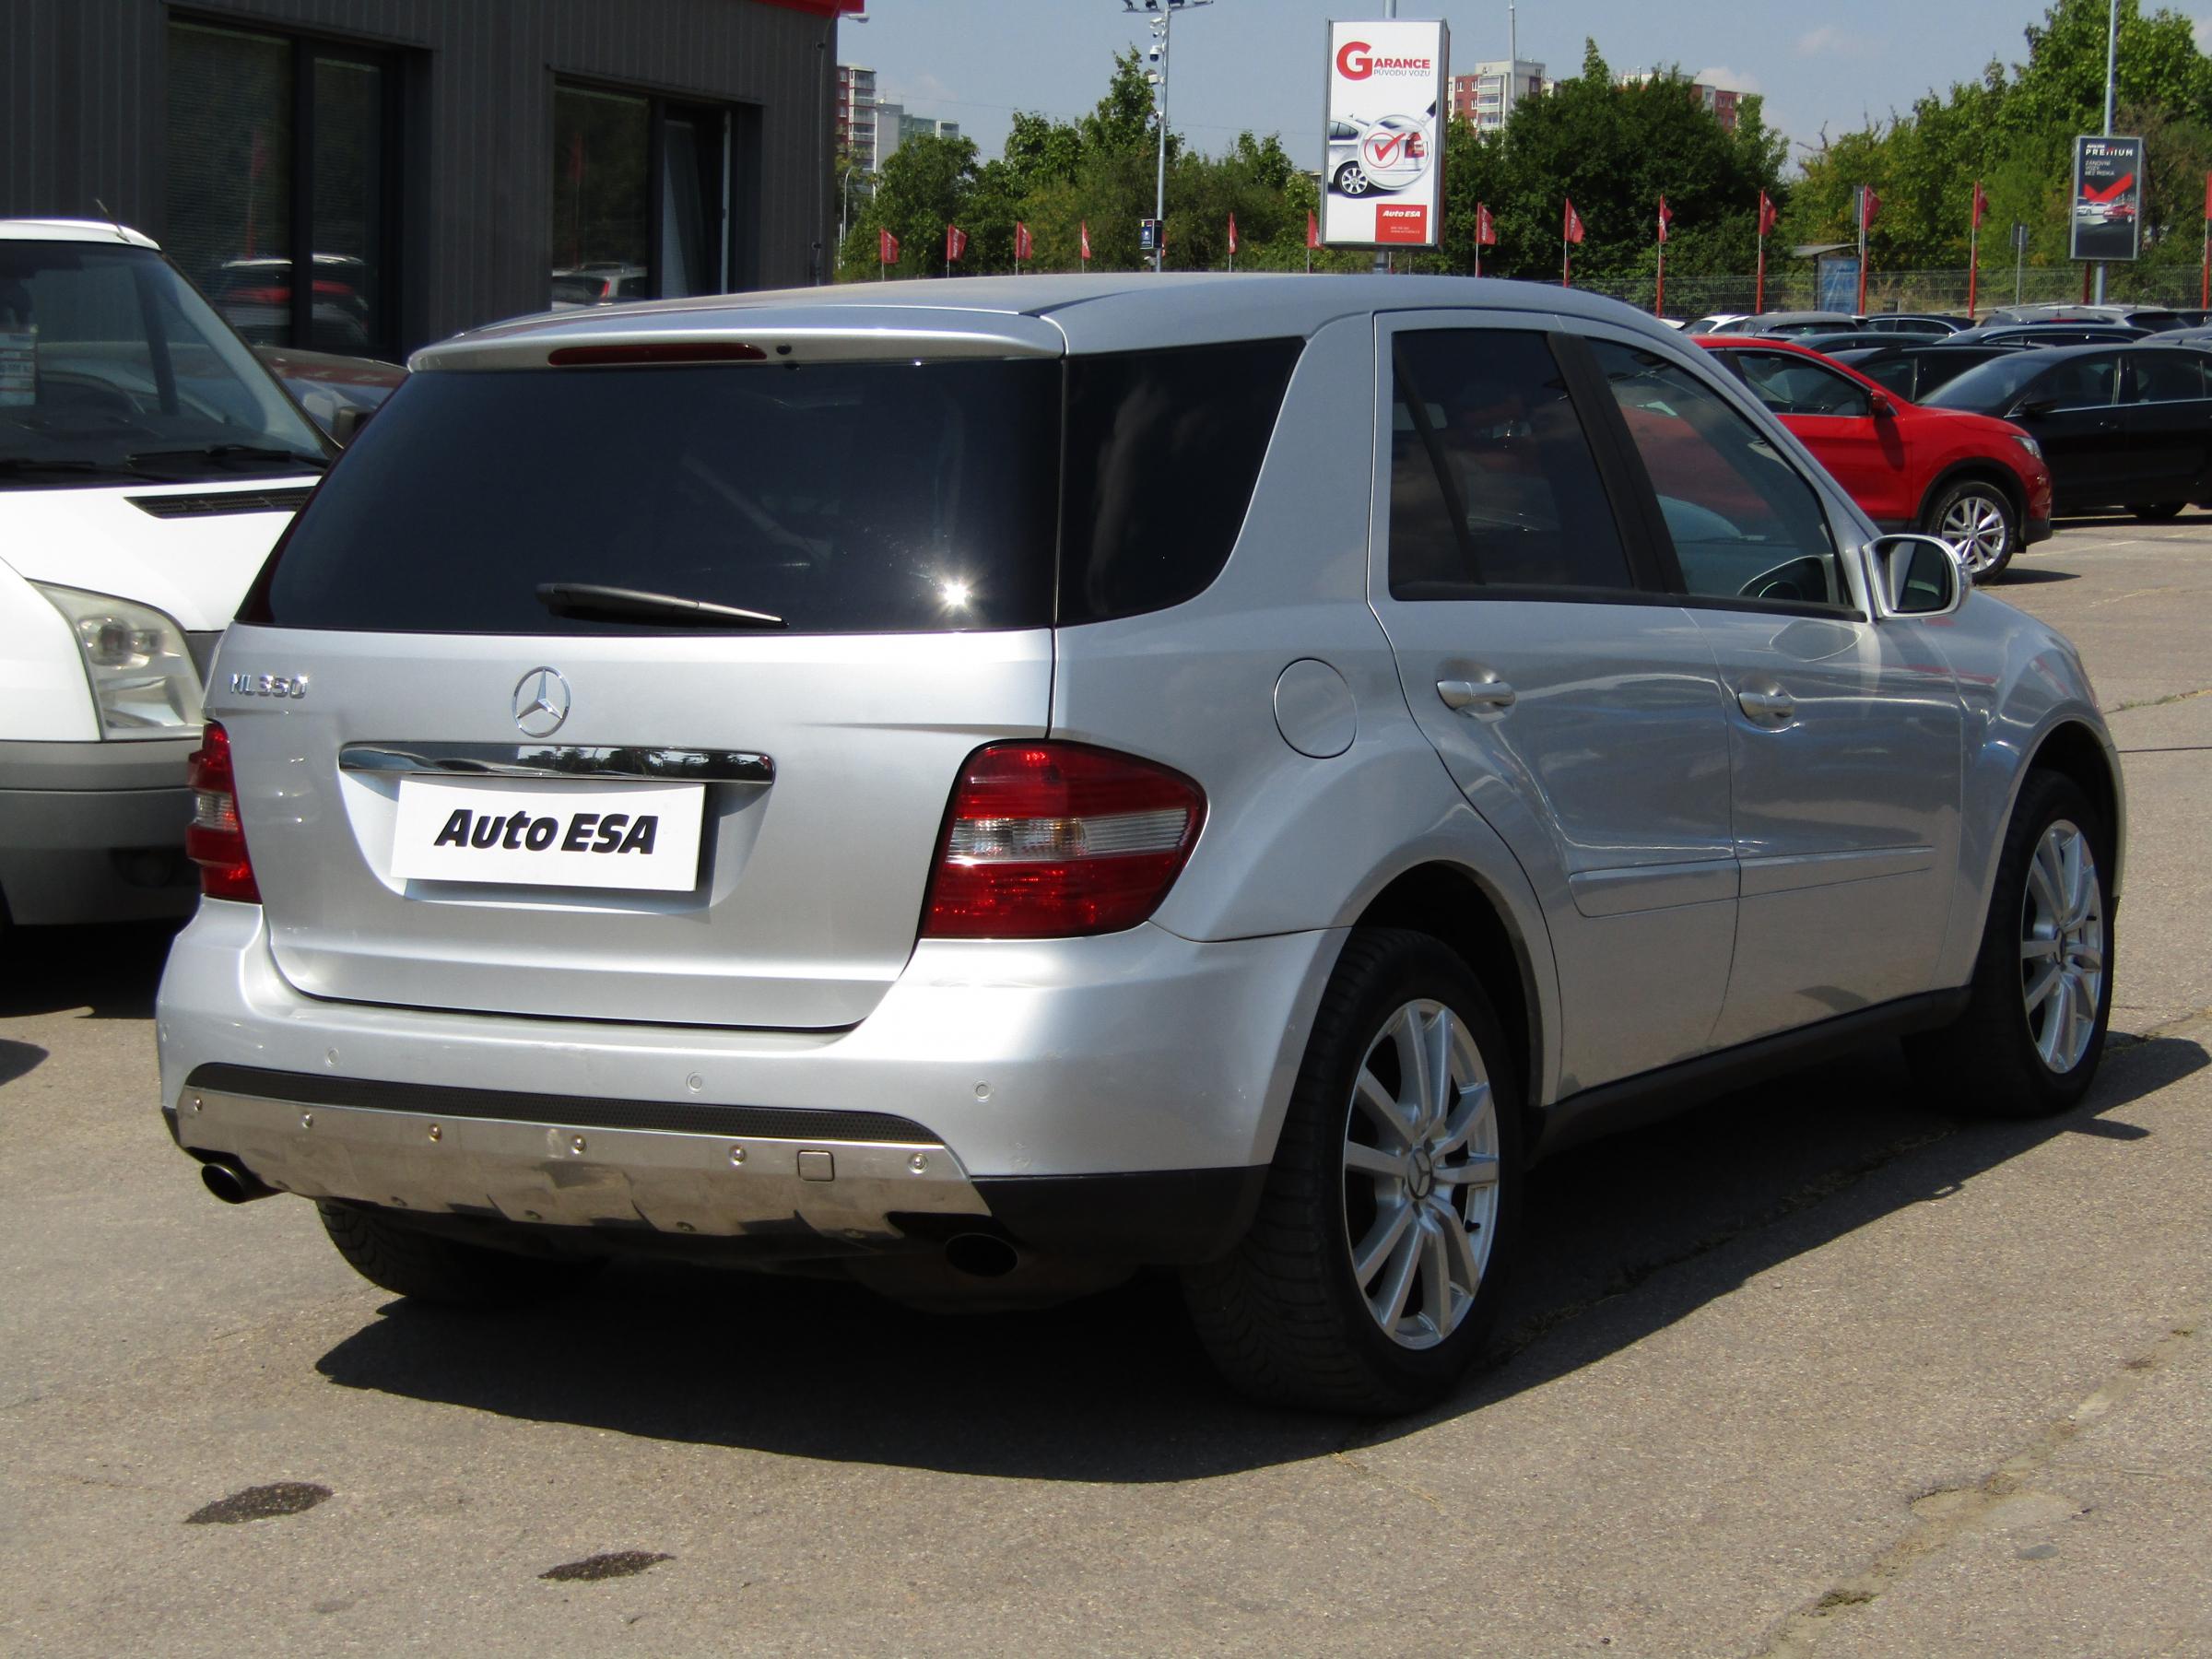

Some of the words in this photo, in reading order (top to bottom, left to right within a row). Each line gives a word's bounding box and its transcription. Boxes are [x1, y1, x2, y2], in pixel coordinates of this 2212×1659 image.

[1336, 41, 1430, 80] GARANCE
[434, 809, 559, 851] Auto
[560, 813, 659, 854] ESA
